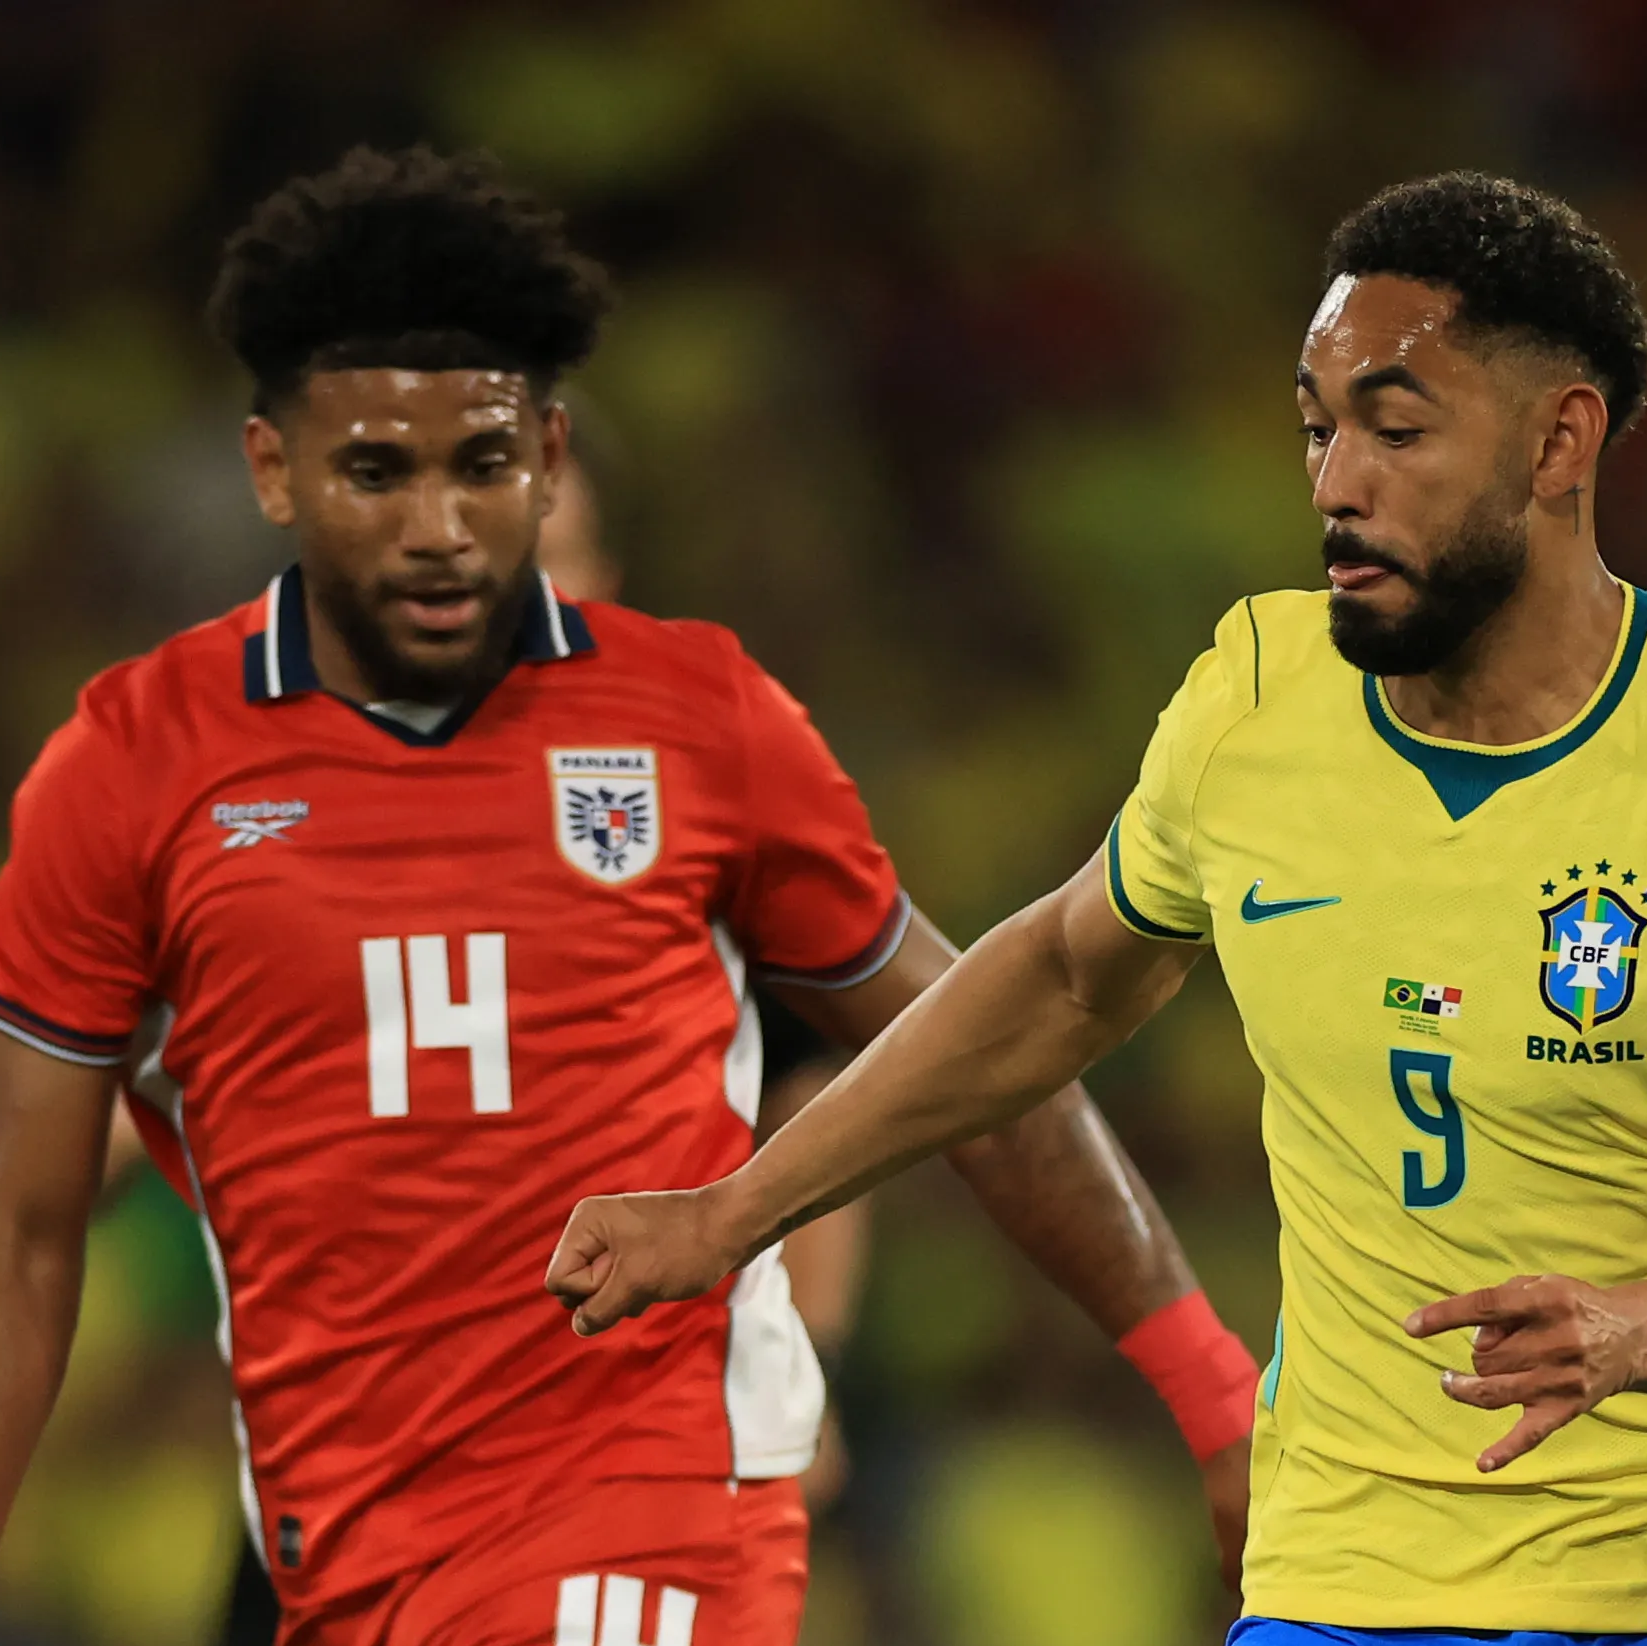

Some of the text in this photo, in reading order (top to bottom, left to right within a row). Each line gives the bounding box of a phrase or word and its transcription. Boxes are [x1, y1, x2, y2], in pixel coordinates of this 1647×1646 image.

[212, 799, 310, 822] Reebok
[1569, 945, 1610, 964] CBF
[361, 932, 513, 1117] 14
[1526, 1034, 1646, 1064] BRASIL
[1389, 1047, 1467, 1210] 9
